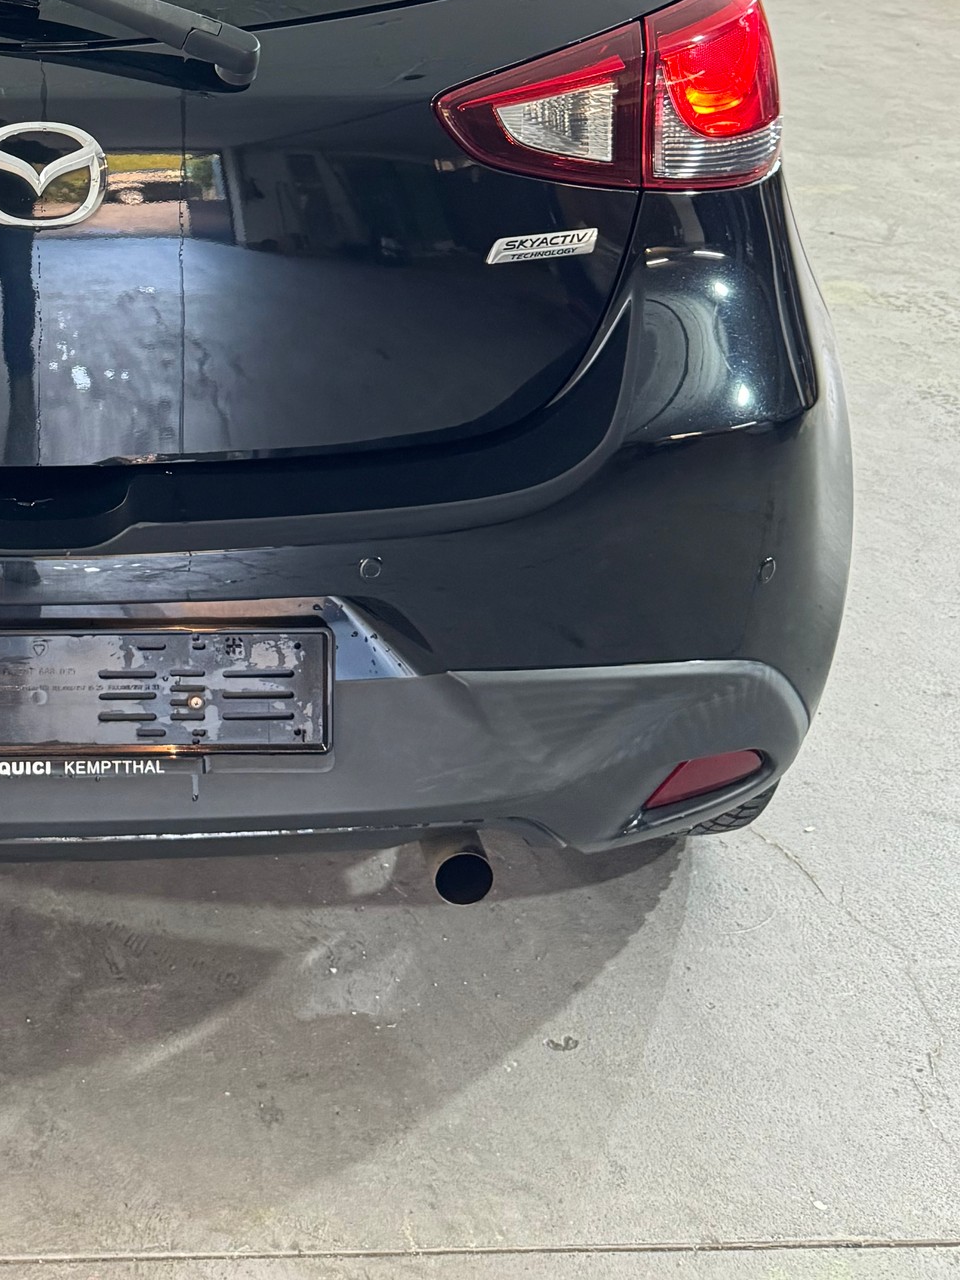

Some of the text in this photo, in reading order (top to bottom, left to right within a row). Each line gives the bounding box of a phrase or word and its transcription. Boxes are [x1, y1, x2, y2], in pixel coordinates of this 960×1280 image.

[503, 231, 589, 251] SKYACTIV
[510, 247, 578, 260] TECHNOLOGY
[64, 760, 166, 775] KEMPTTHAL
